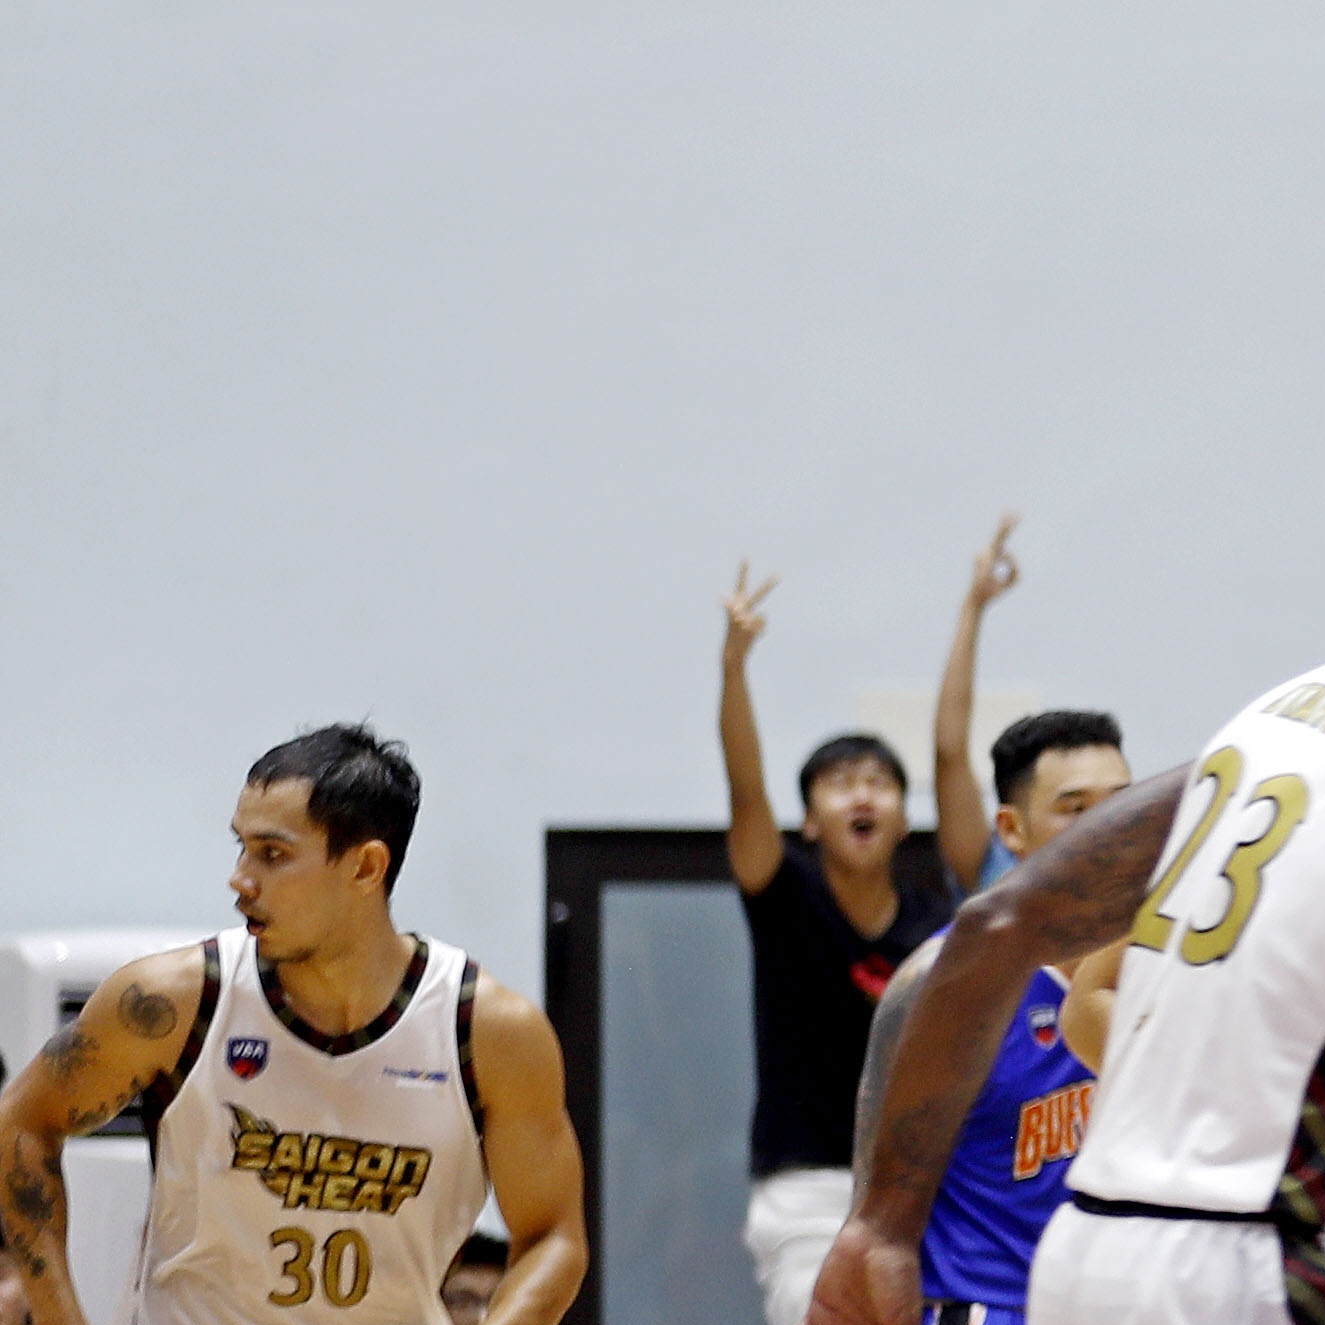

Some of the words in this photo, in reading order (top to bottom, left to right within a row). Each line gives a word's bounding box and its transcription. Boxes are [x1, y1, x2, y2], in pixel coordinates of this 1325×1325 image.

[1130, 745, 1309, 966] 23
[232, 1130, 432, 1186] SAIGON
[283, 1170, 420, 1215] HEAT
[269, 1226, 371, 1307] 30
